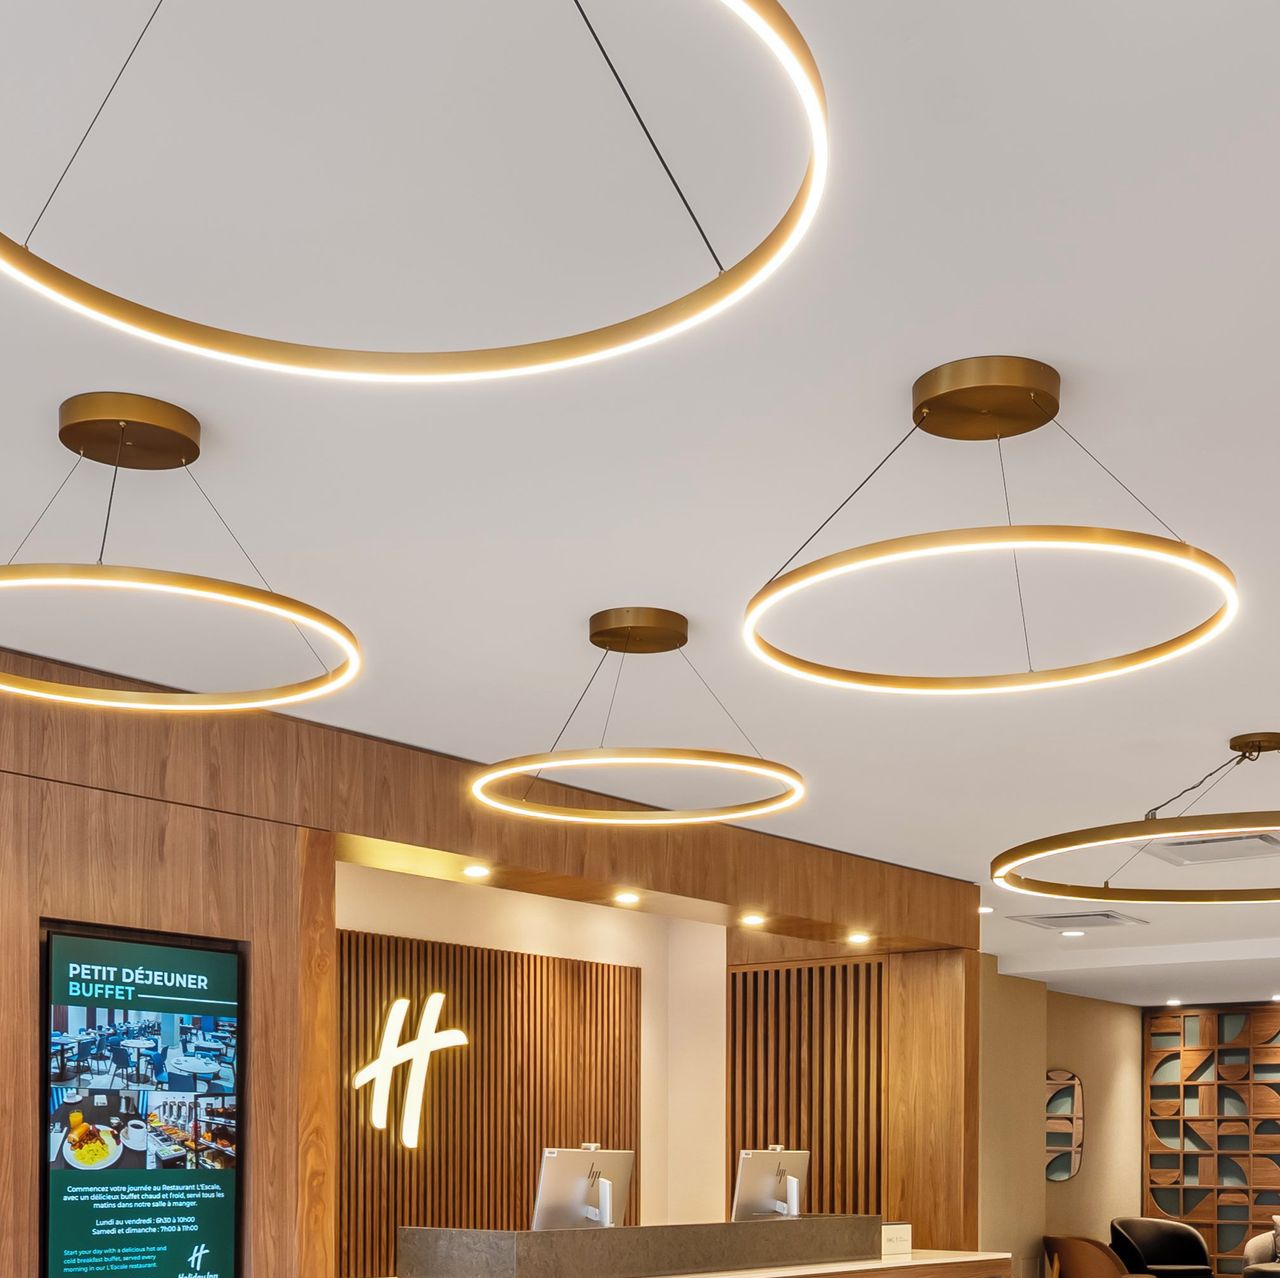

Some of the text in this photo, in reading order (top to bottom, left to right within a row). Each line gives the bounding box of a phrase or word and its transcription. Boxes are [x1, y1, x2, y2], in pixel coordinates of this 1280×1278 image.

[69, 963, 208, 990] PETIT DÉJEUNER
[69, 981, 136, 1000] BUFFET
[588, 1162, 601, 1188] hp
[776, 1161, 786, 1184] hp
[125, 1226, 156, 1234] dimanche
